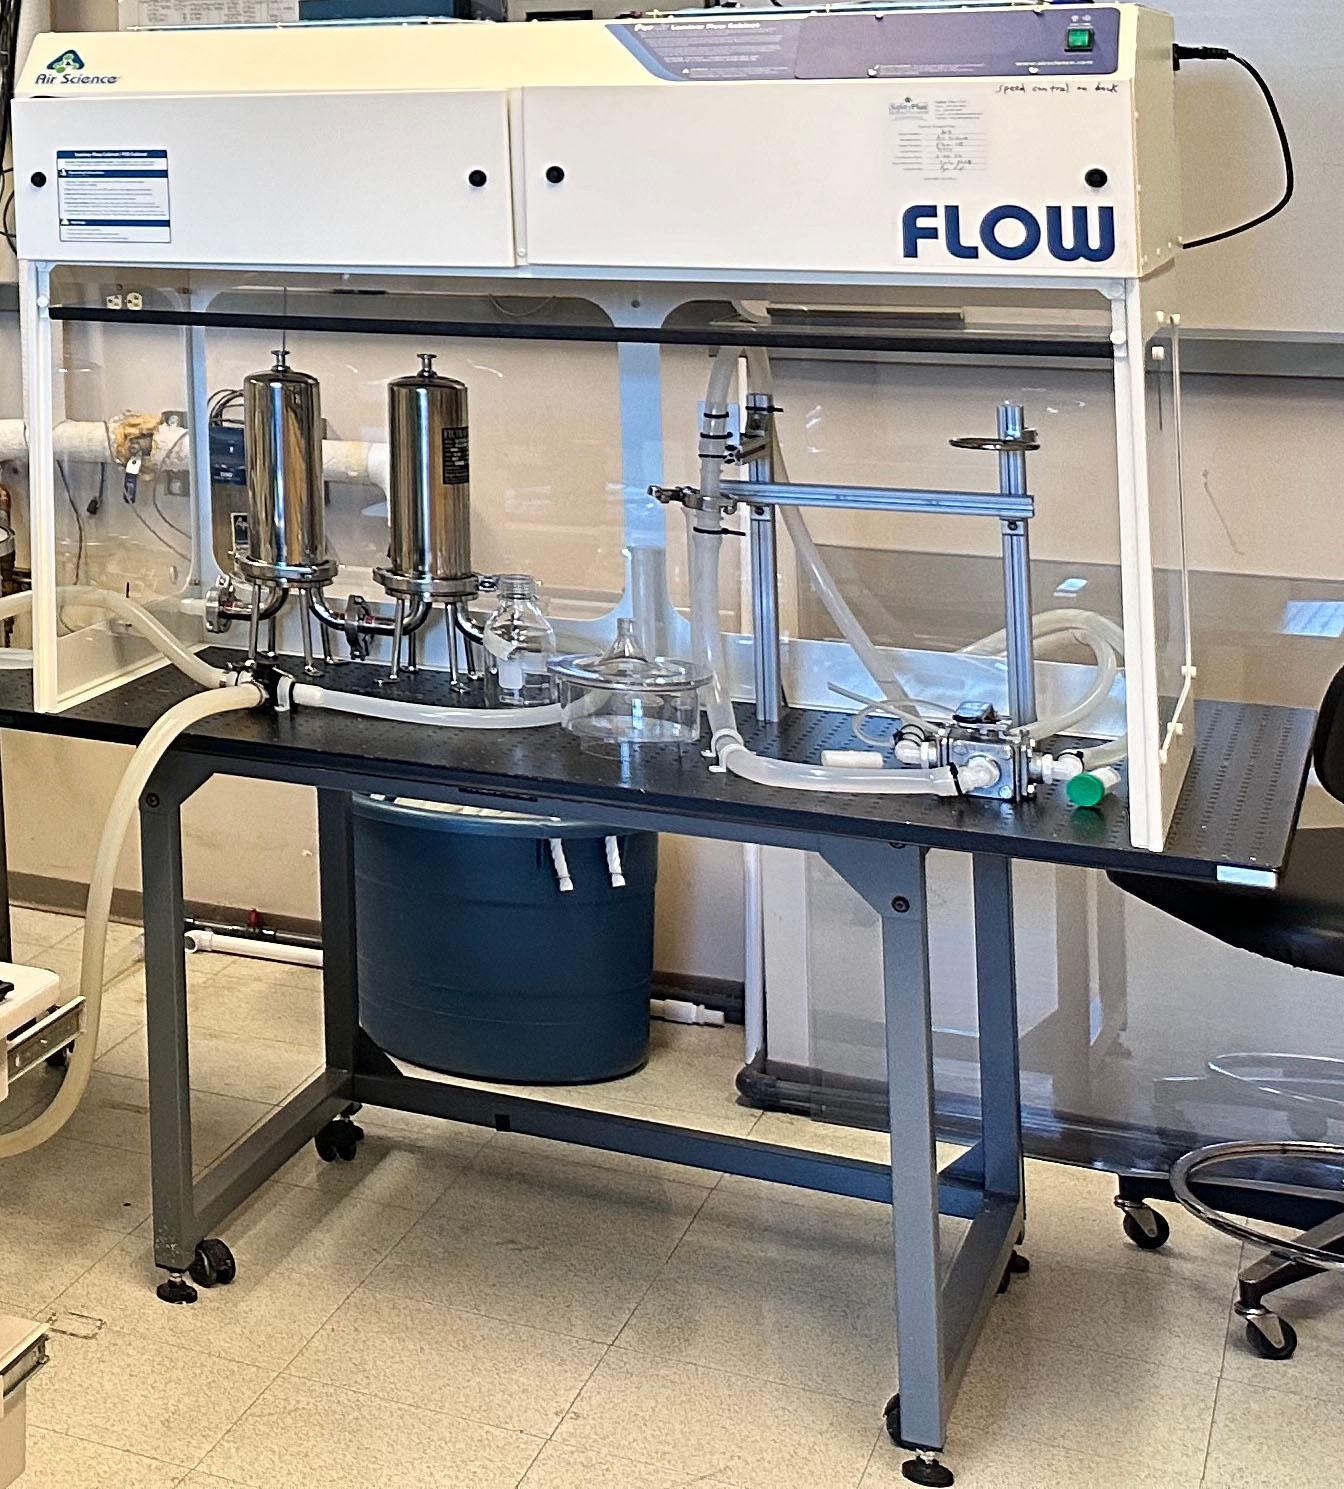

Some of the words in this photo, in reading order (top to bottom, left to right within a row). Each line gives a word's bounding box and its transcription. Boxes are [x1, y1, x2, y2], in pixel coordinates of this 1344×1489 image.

[35, 74, 57, 84] Air
[60, 74, 118, 84] Science
[902, 204, 1116, 262] FLOW
